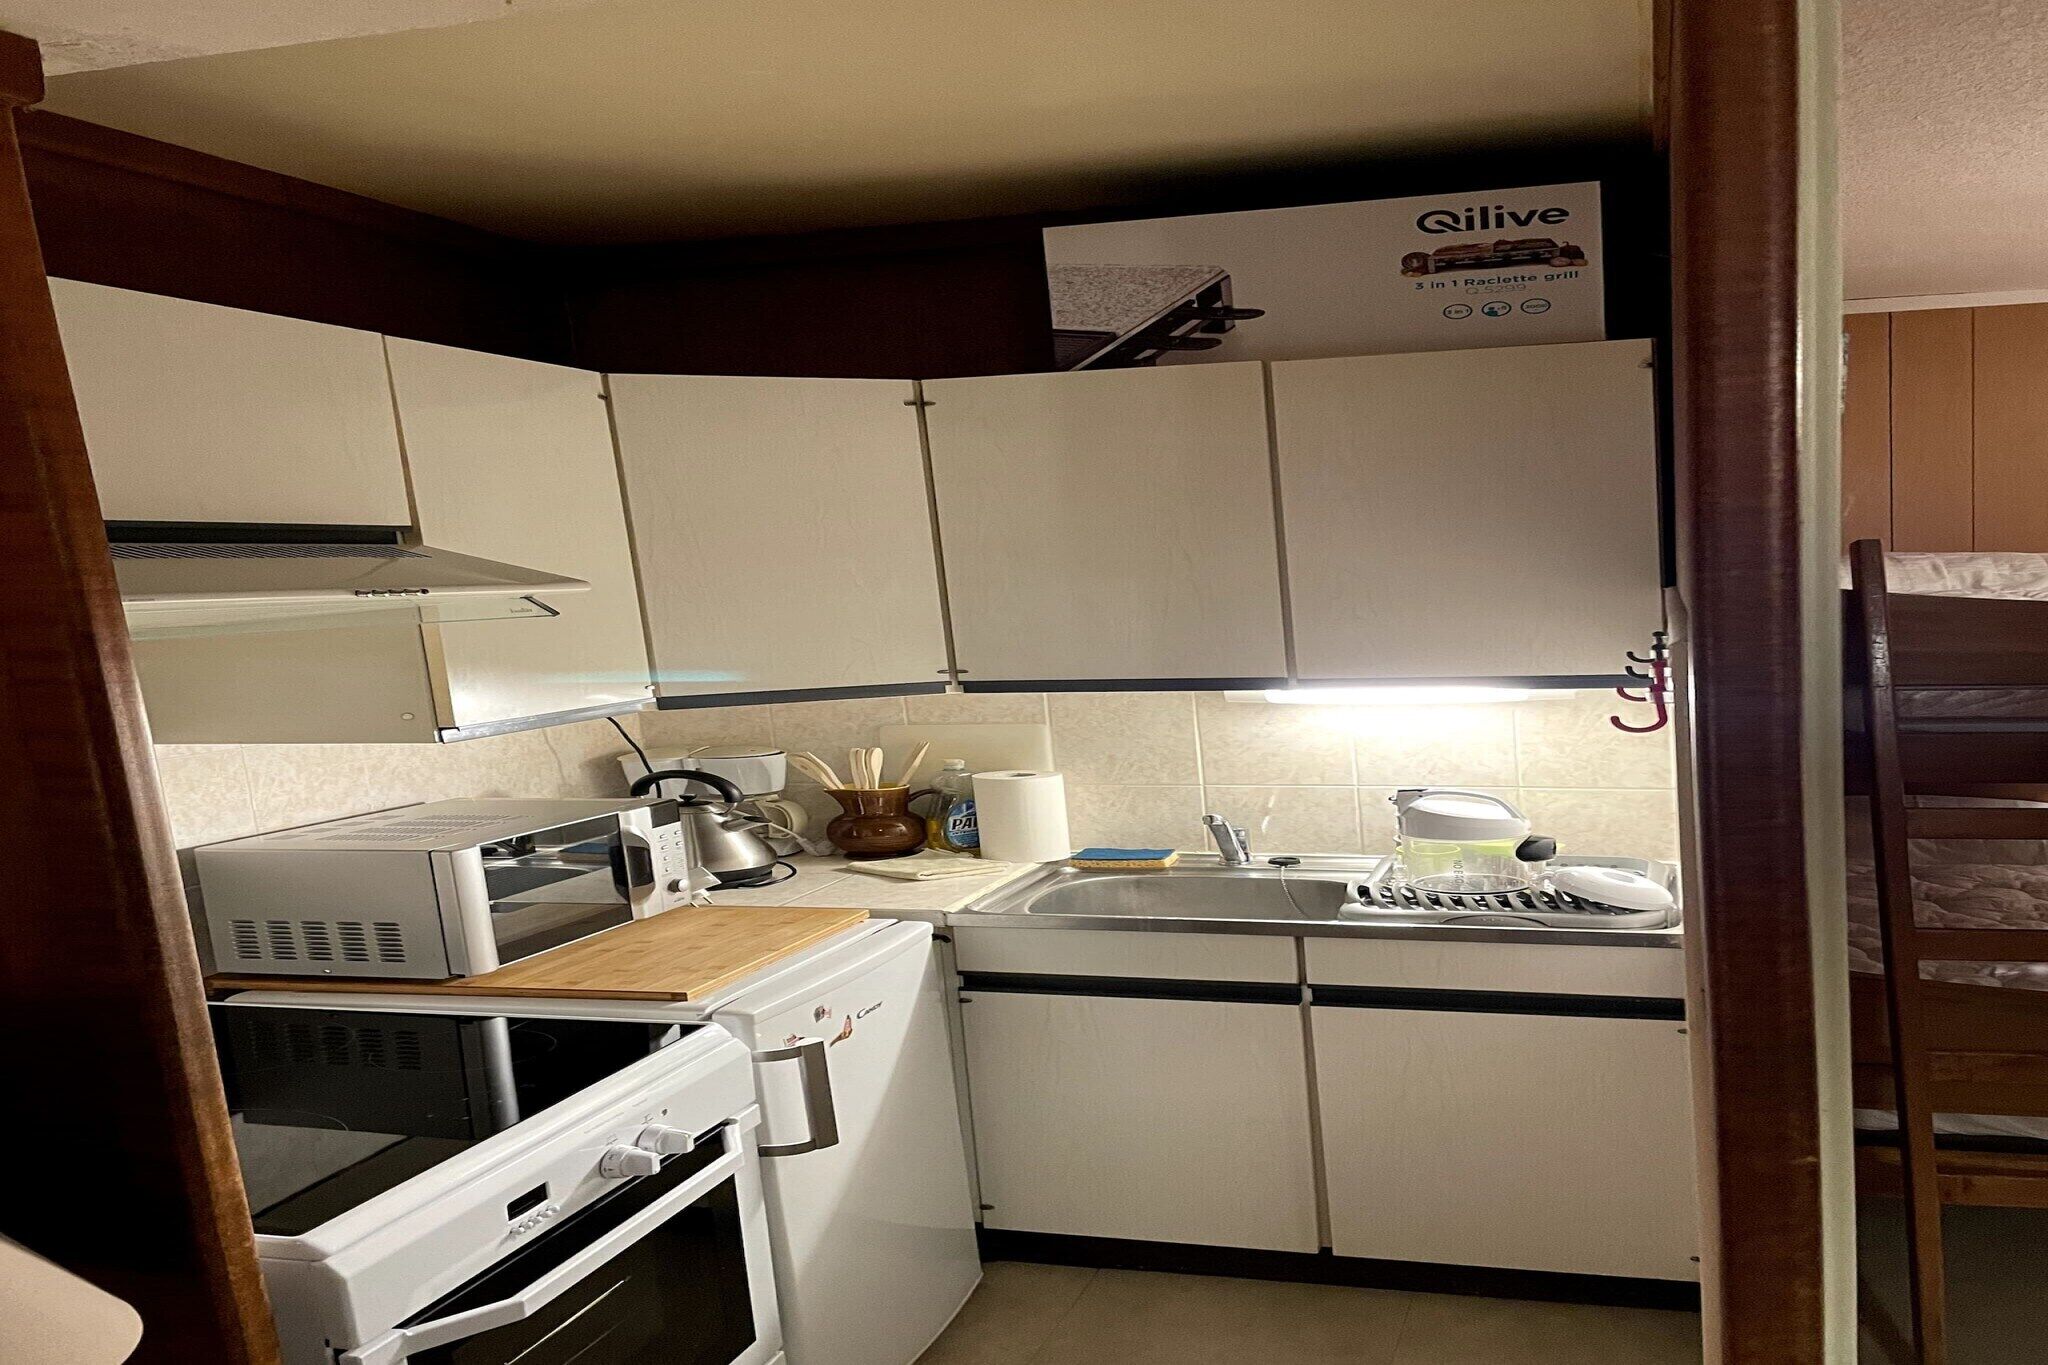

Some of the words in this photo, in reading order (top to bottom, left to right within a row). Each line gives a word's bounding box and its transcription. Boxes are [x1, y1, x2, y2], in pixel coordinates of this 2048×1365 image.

[1416, 205, 1570, 234] Qilive
[1415, 282, 1424, 290] 3
[1431, 281, 1445, 290] in
[1464, 273, 1538, 287] Raclette
[1544, 270, 1578, 282] grill
